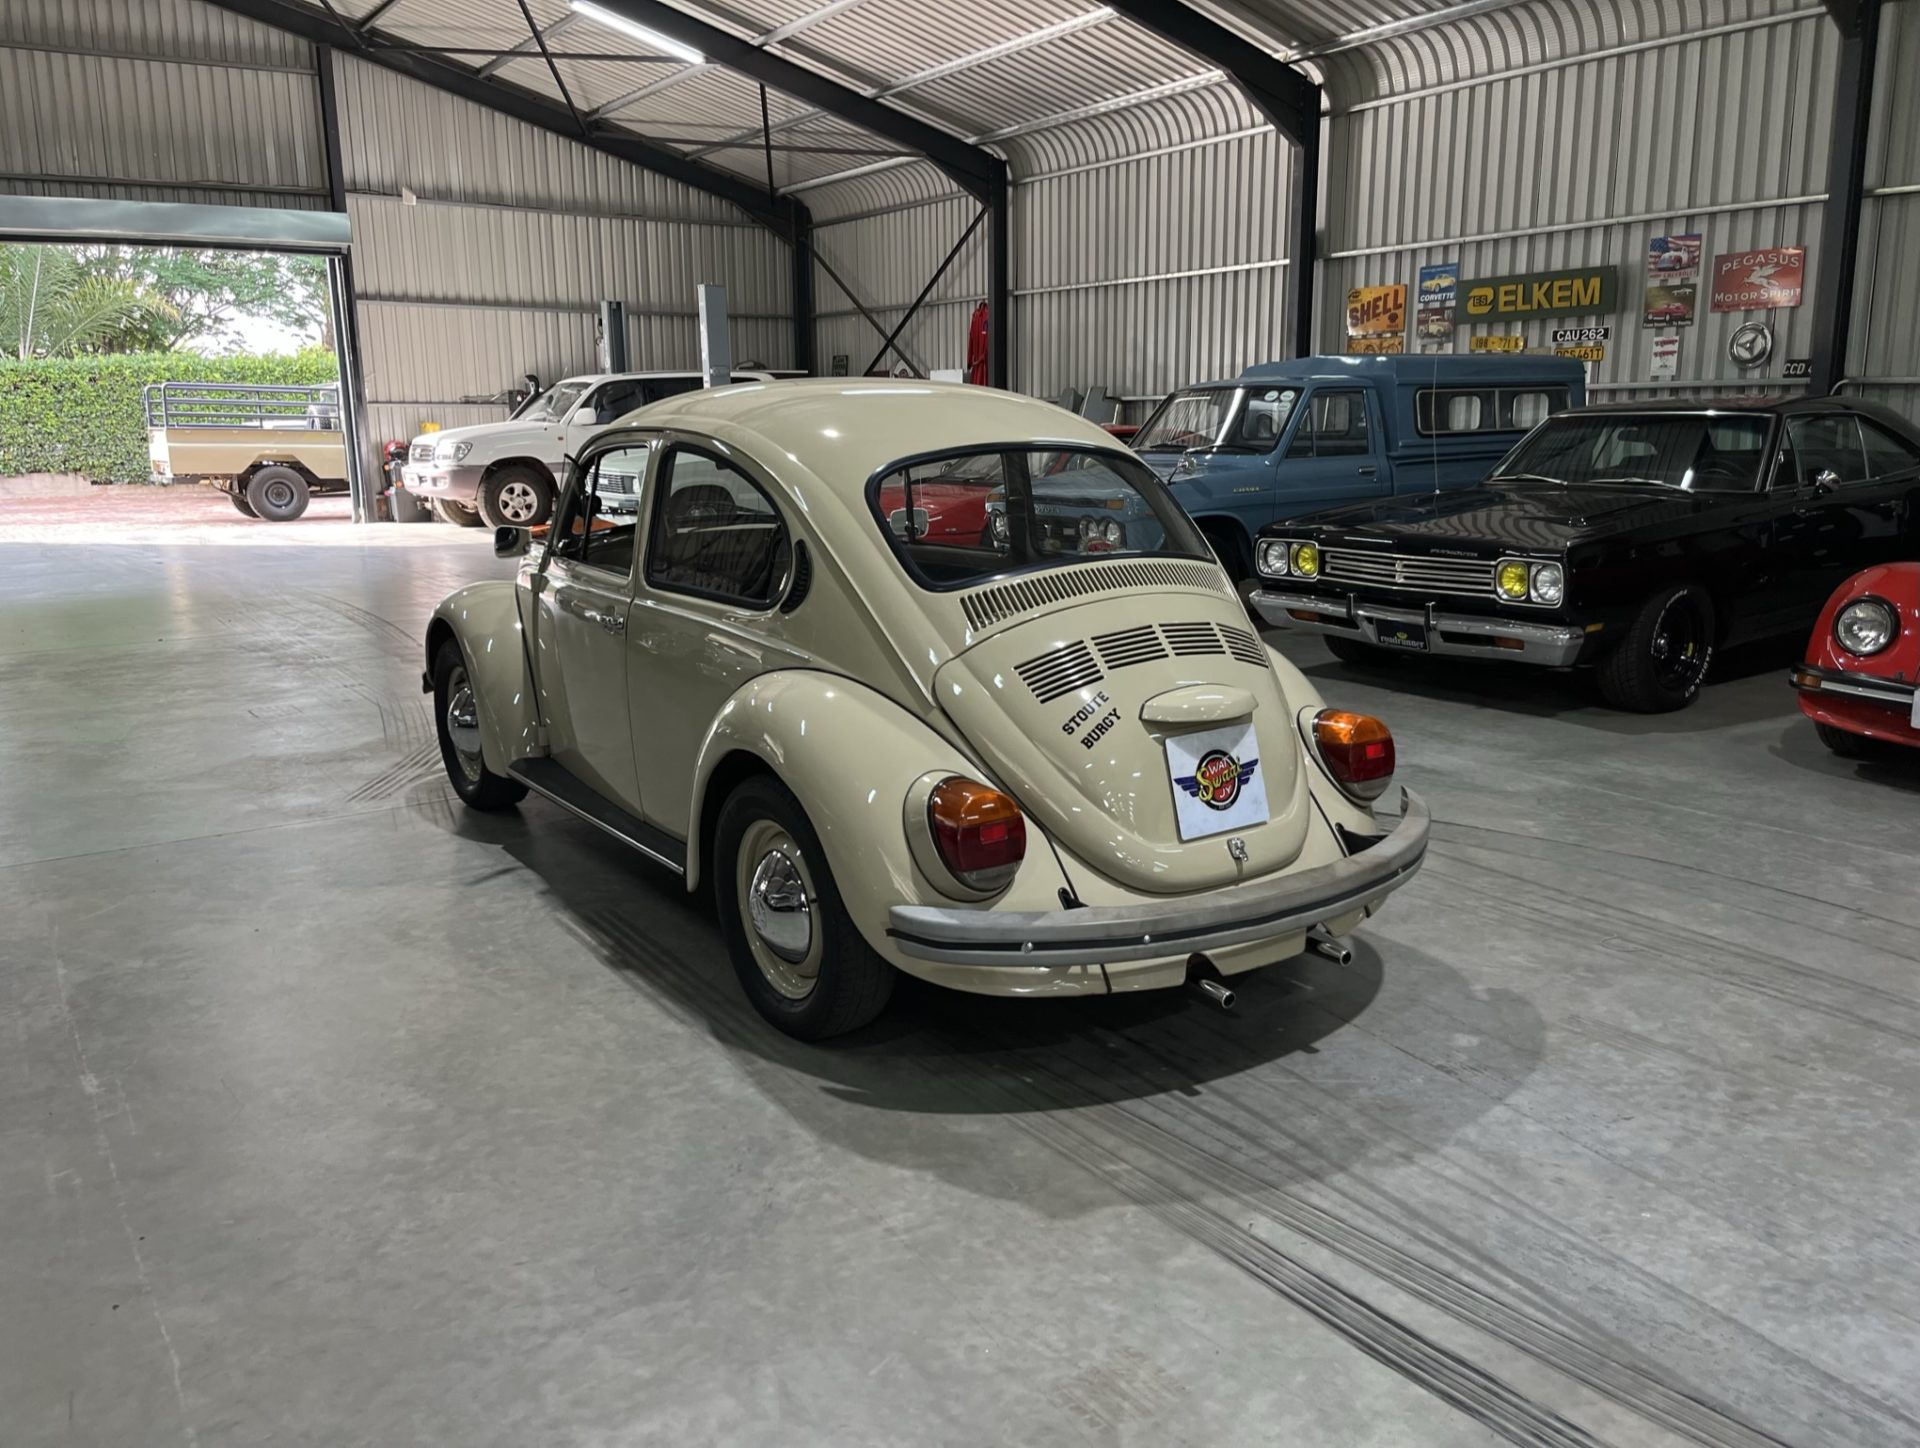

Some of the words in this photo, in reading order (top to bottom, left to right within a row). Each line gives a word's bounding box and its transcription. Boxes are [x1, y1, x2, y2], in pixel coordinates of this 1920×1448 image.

[1721, 253, 1800, 275] PEGASUS
[1419, 292, 1456, 302] CORVETTE
[1474, 296, 1487, 306] ES
[1498, 276, 1601, 312] ELKEM
[1714, 292, 1758, 303] MOTOR
[1760, 287, 1802, 299] SPIRIT
[1349, 288, 1403, 328] SHELL
[1783, 363, 1806, 375] CCD
[1062, 691, 1110, 735] STOUTE
[1080, 707, 1121, 750] BURGY
[1219, 785, 1232, 799] JY
